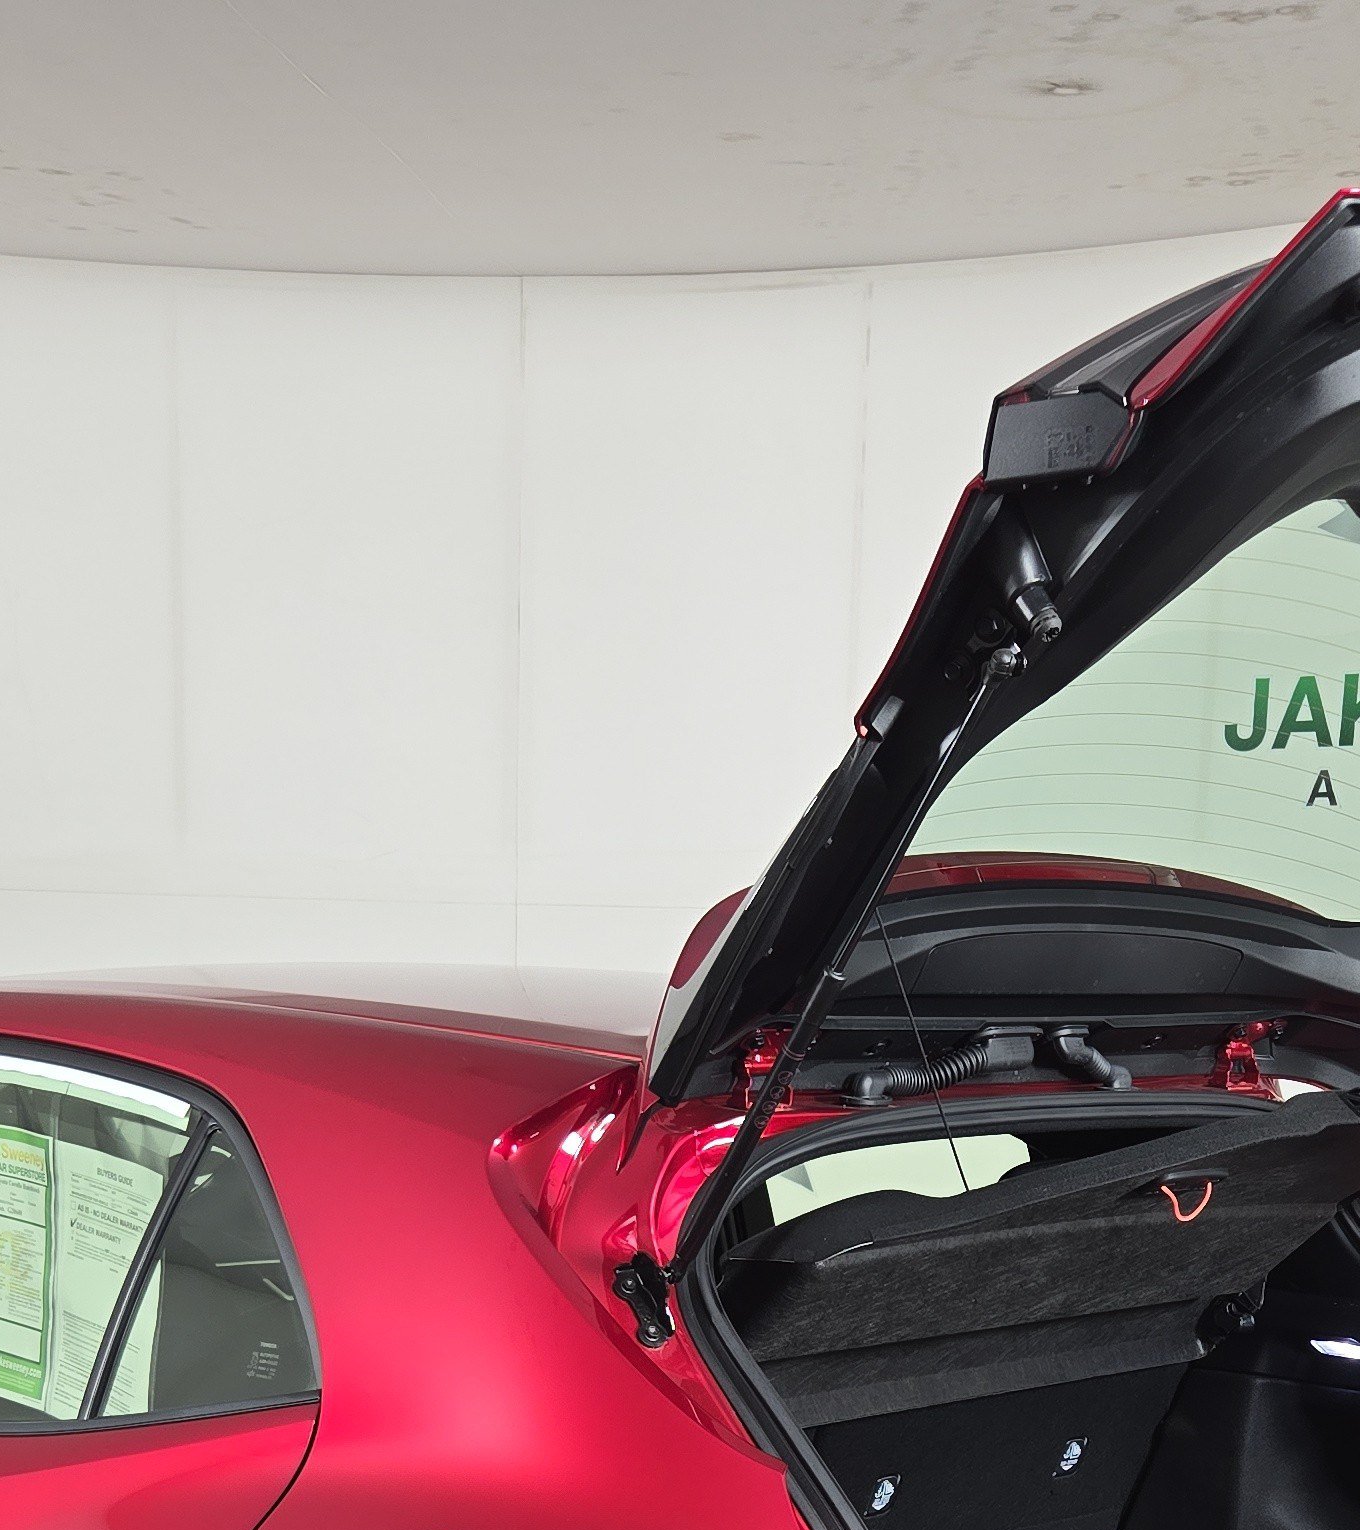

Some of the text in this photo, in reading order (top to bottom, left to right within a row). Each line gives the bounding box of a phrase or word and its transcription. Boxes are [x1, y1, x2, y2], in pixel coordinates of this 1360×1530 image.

[8, 1163, 45, 1183] SUPERSTORE
[97, 1167, 117, 1181] BUYERS
[101, 1211, 118, 1224] DEALER
[76, 1222, 95, 1235] DEALER
